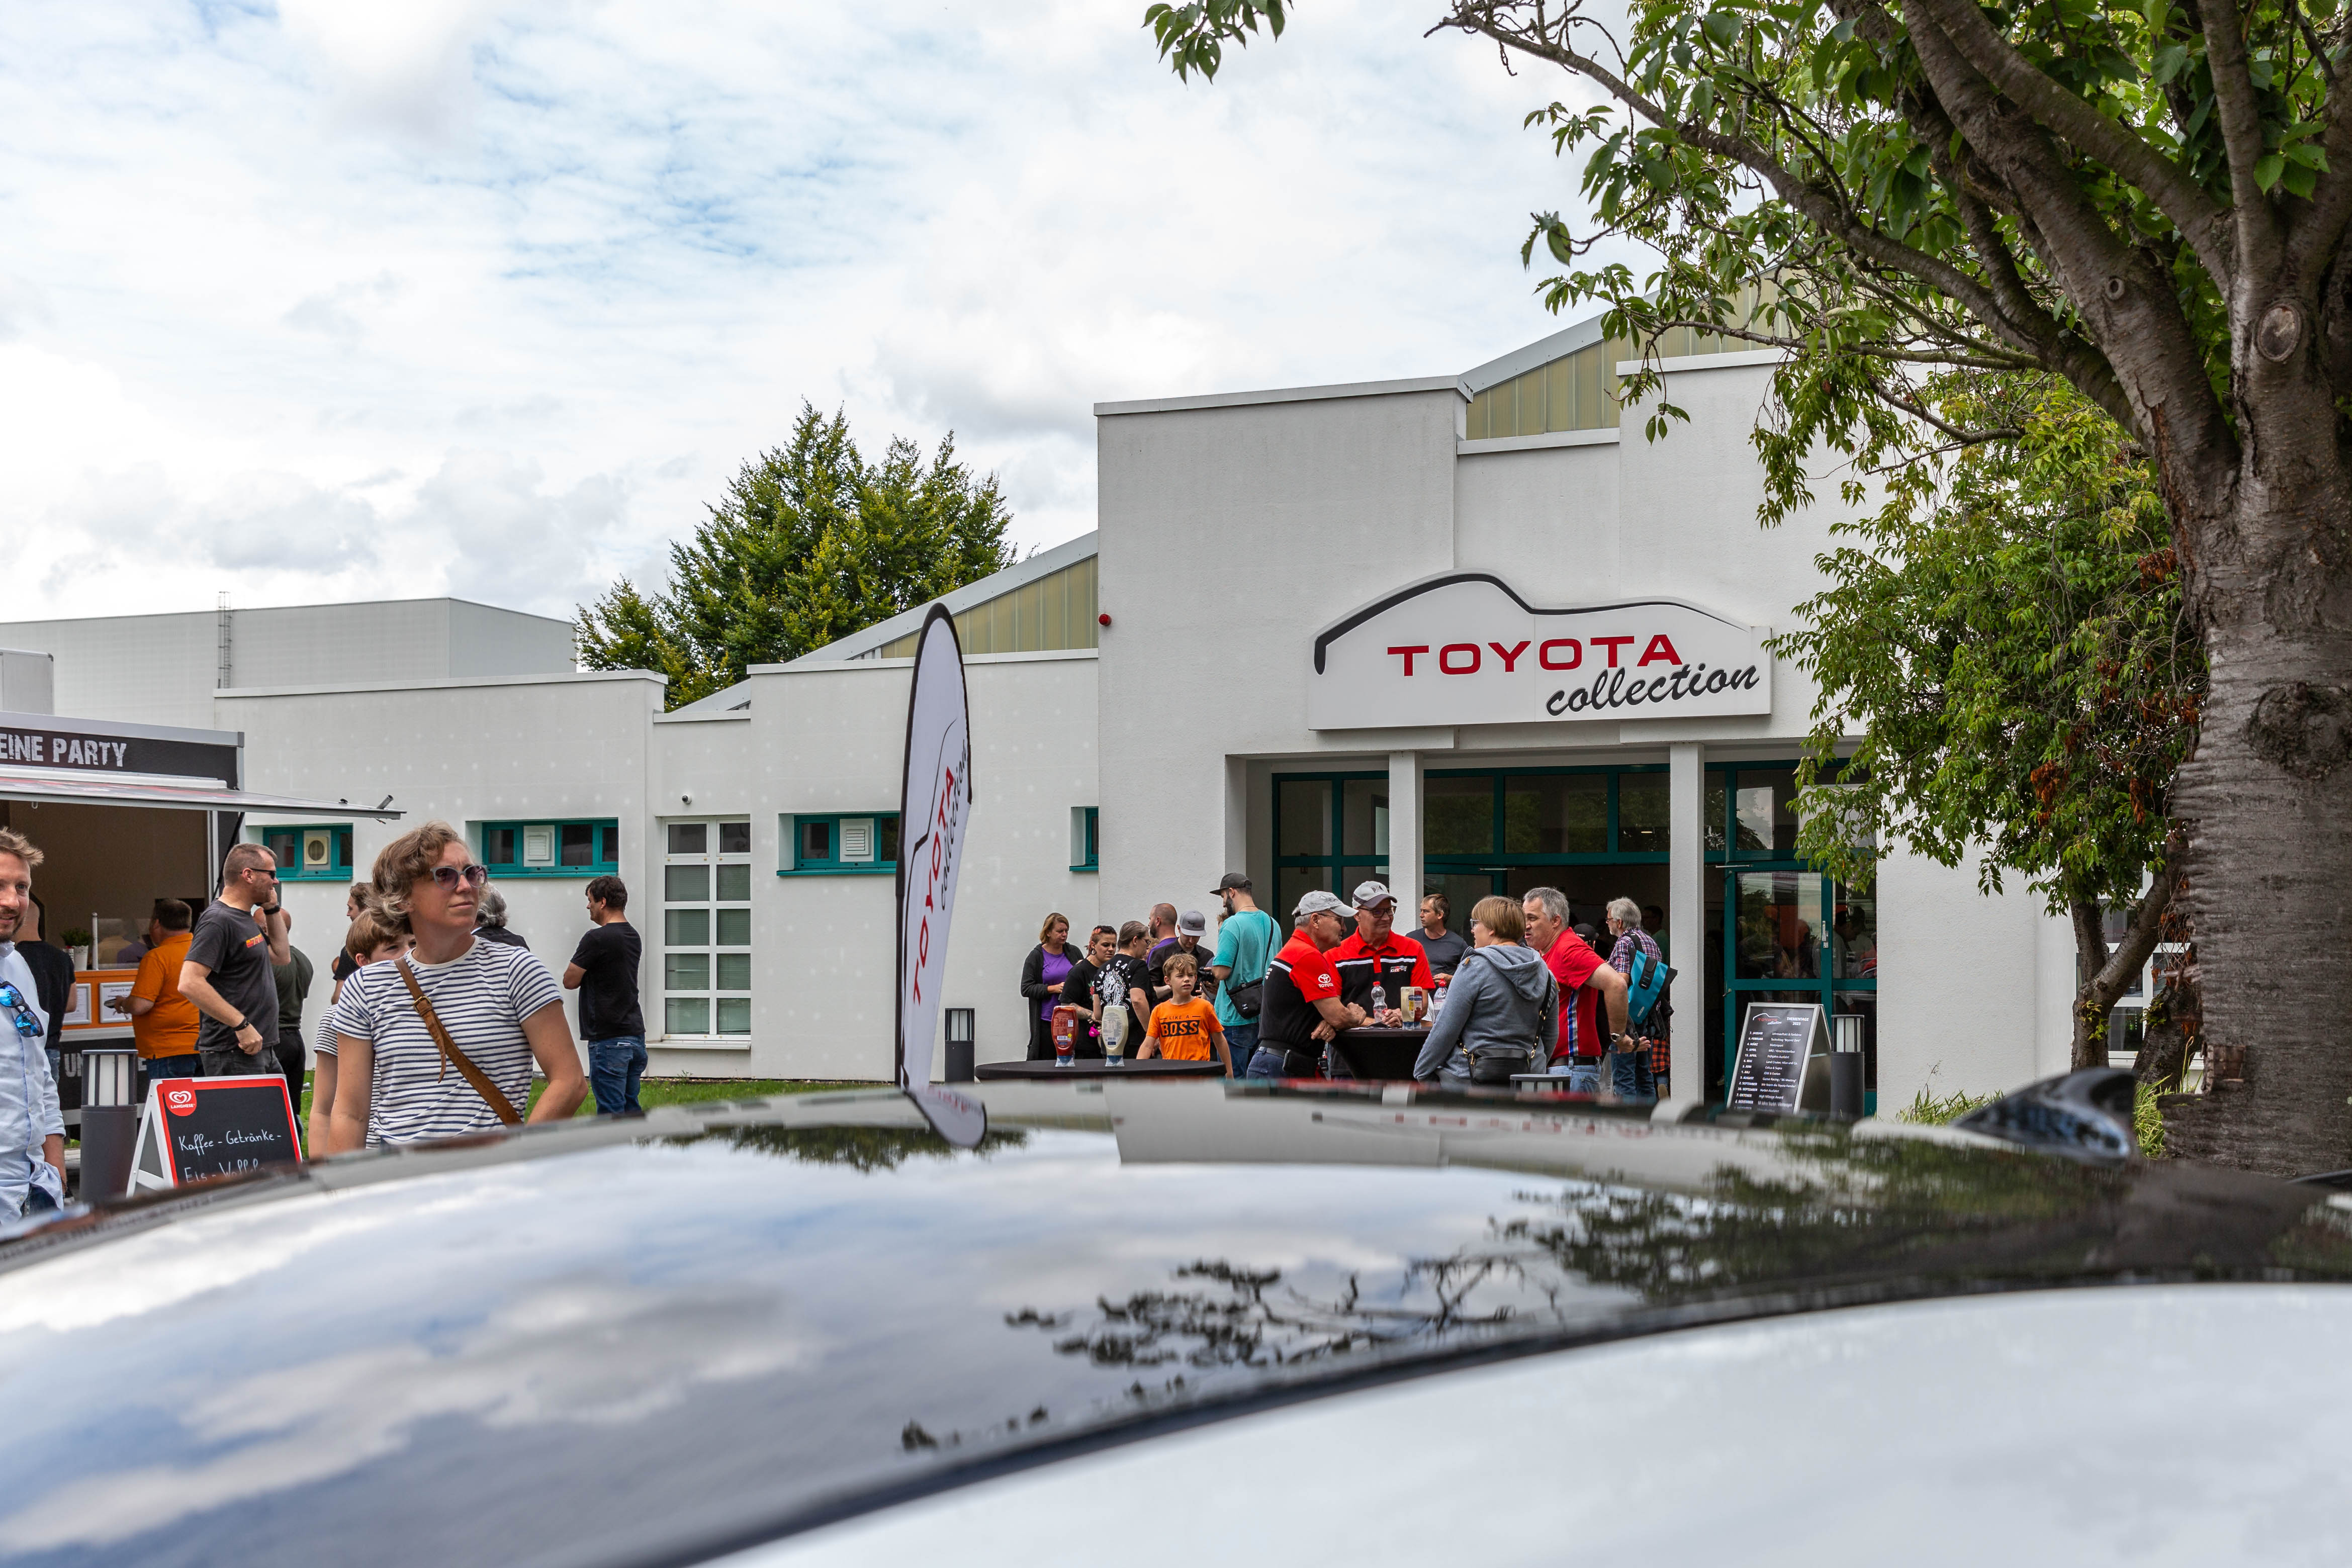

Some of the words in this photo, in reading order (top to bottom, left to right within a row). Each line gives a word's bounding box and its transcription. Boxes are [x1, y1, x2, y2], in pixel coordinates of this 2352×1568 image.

[1387, 633, 1682, 677] TOYOTA
[1546, 663, 1760, 717] collection
[52, 738, 127, 767] PARTY
[941, 739, 966, 910] collection
[913, 766, 954, 1006] TOYOTA
[1161, 1021, 1198, 1036] BOSS
[178, 1133, 214, 1156] Kaffee
[226, 1129, 275, 1145] Getränke
[185, 1167, 208, 1183] Eis
